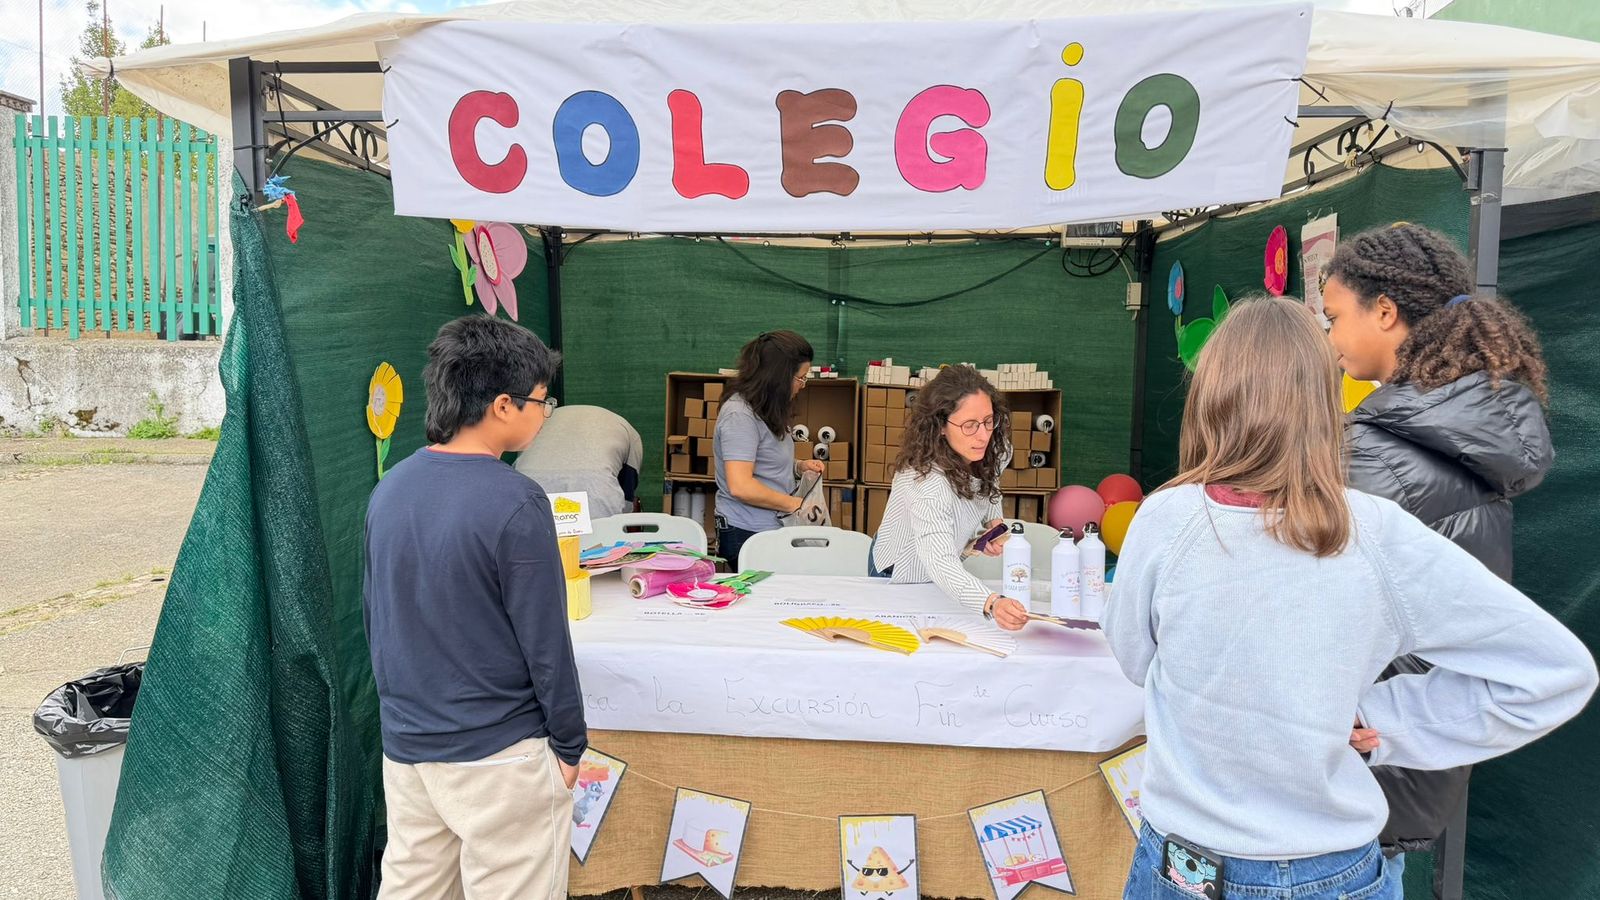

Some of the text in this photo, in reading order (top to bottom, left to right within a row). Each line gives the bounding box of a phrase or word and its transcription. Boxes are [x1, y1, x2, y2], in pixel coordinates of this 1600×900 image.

[653, 675, 696, 715] la
[723, 676, 887, 719] Excursión
[913, 680, 964, 728] Fin
[1003, 683, 1089, 729] Curso
